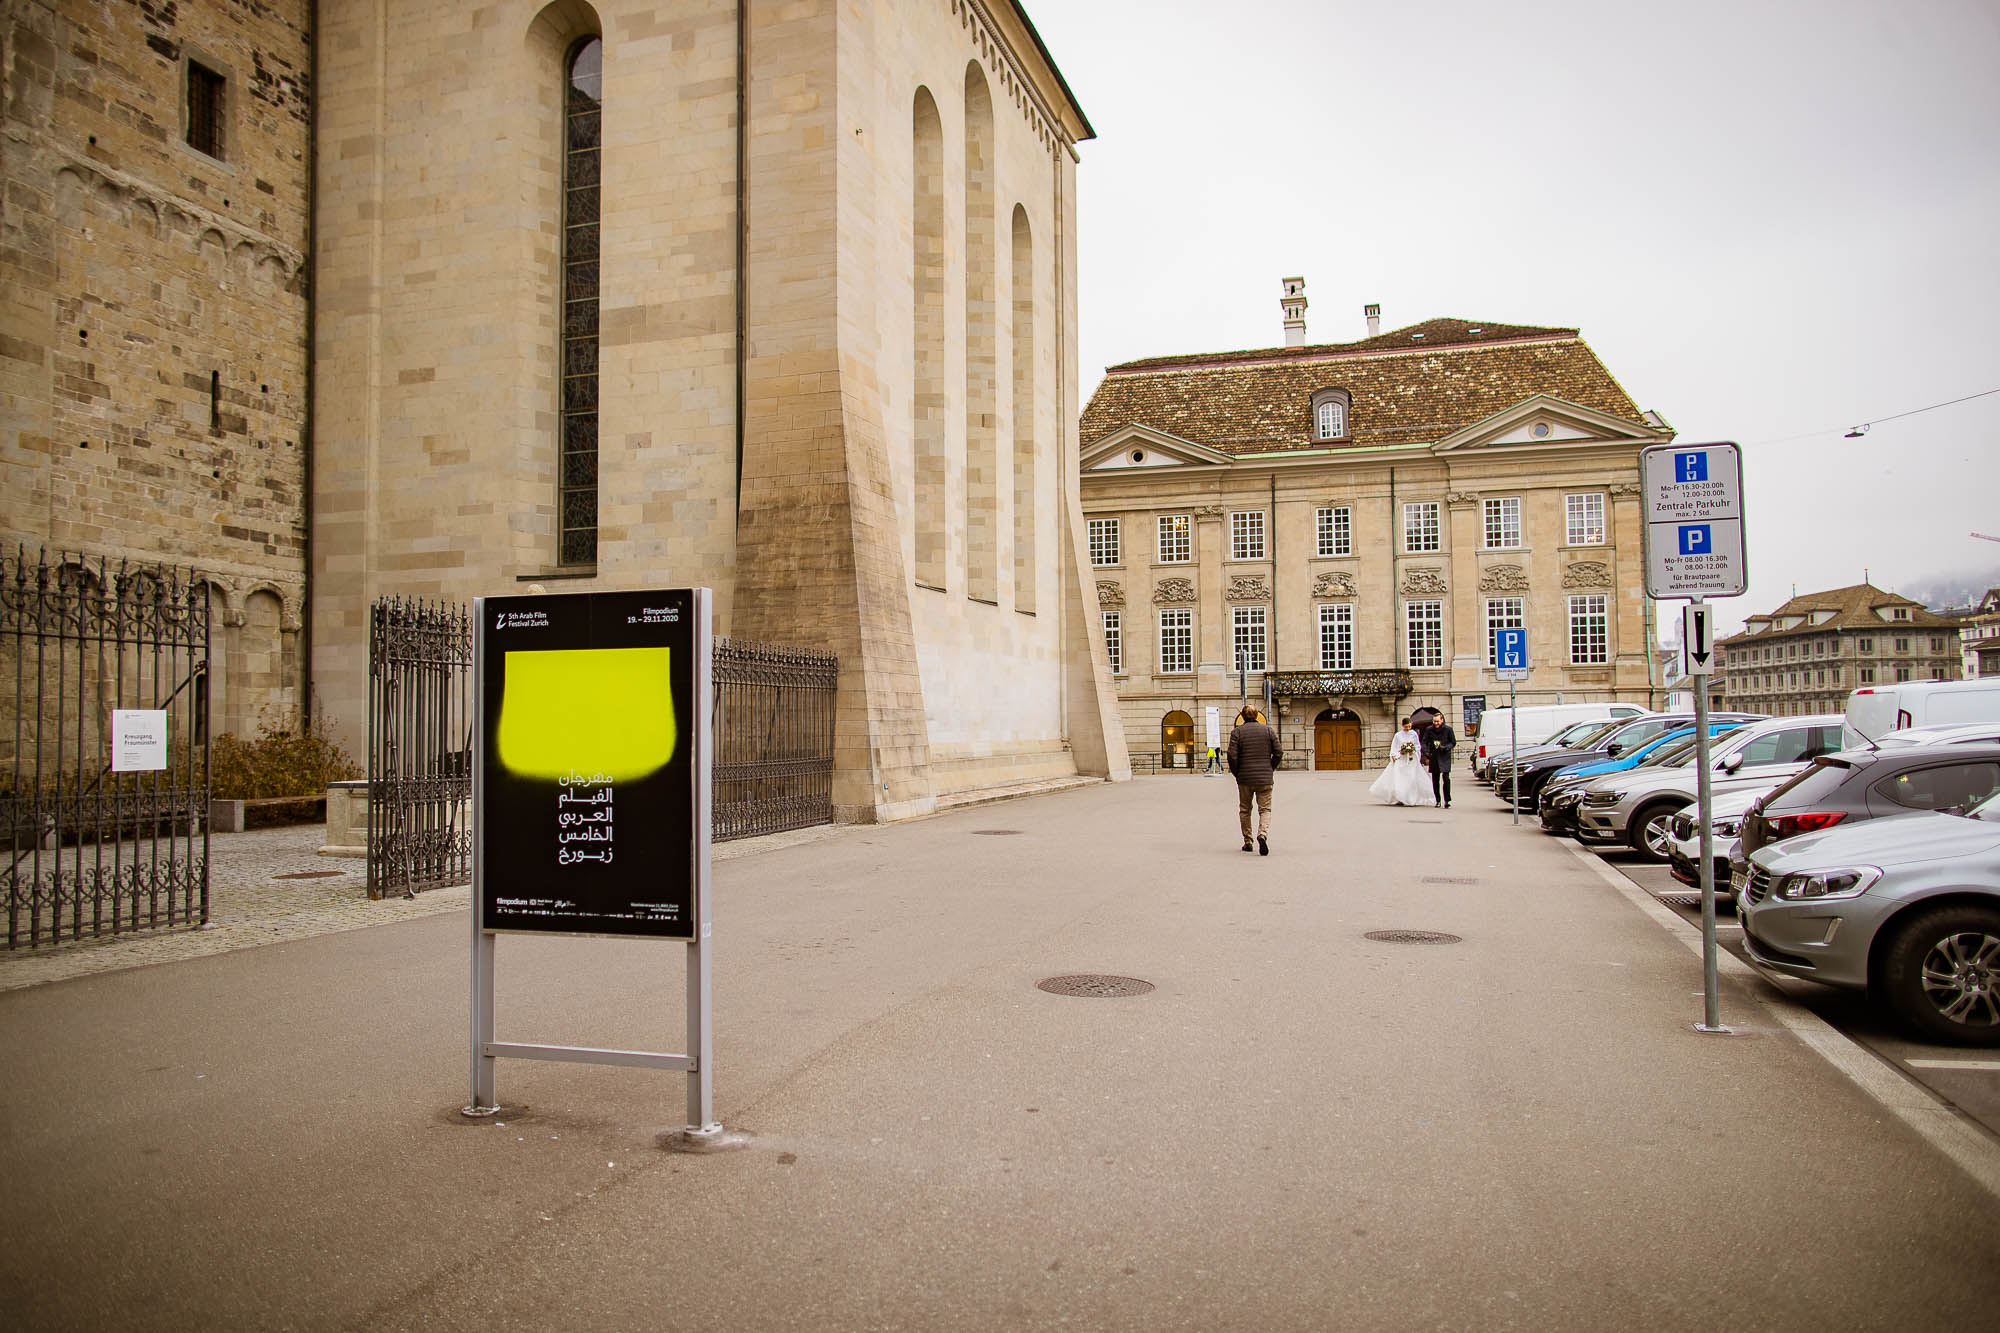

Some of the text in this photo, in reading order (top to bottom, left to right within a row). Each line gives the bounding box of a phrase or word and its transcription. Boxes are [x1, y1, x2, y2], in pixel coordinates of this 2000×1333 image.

[1686, 455, 1697, 470] P
[1682, 482, 1724, 491] 16.30-20.00h
[1682, 489, 1725, 498] 12.00-20.00h
[1656, 499, 1731, 511] Zentrale Parkuhr
[1699, 509, 1712, 517] Std.
[1687, 530, 1703, 551] P
[1684, 562, 1728, 571] 08.00-12.00h
[1684, 573, 1721, 582] Brautpaare
[1669, 581, 1725, 590] während Trauung
[508, 611, 547, 620] 5th Arab Film
[643, 607, 679, 615] Filmpodium
[508, 619, 530, 627] Festival
[1505, 632, 1518, 651] P
